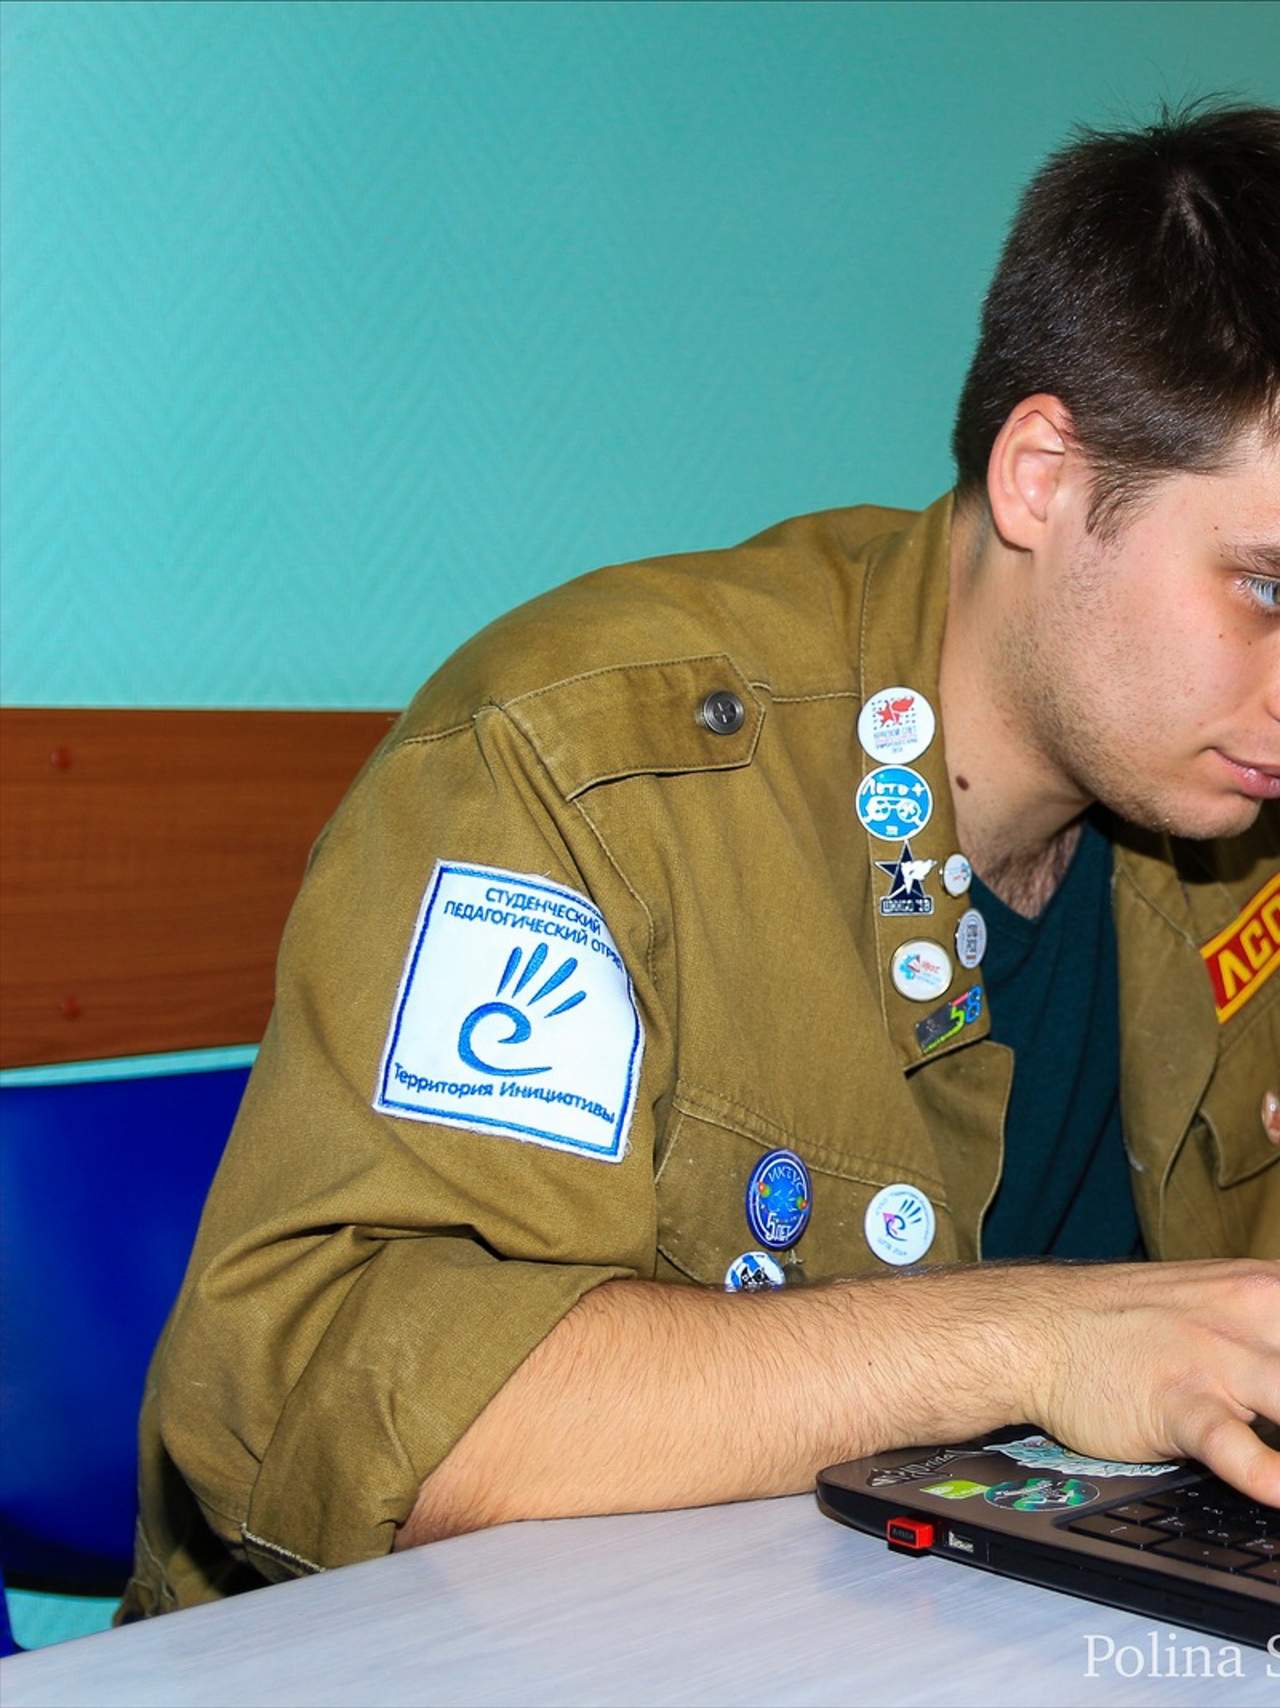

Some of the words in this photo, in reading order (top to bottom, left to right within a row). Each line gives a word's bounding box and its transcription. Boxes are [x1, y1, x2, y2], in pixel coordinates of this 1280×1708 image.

[444, 900, 588, 946] ПЕДАГОГИЧЕСКИЙ
[485, 887, 601, 936] СТУДЕНЧЕСКИЙ
[394, 1062, 494, 1099] Территория
[499, 1081, 616, 1124] Инициативы
